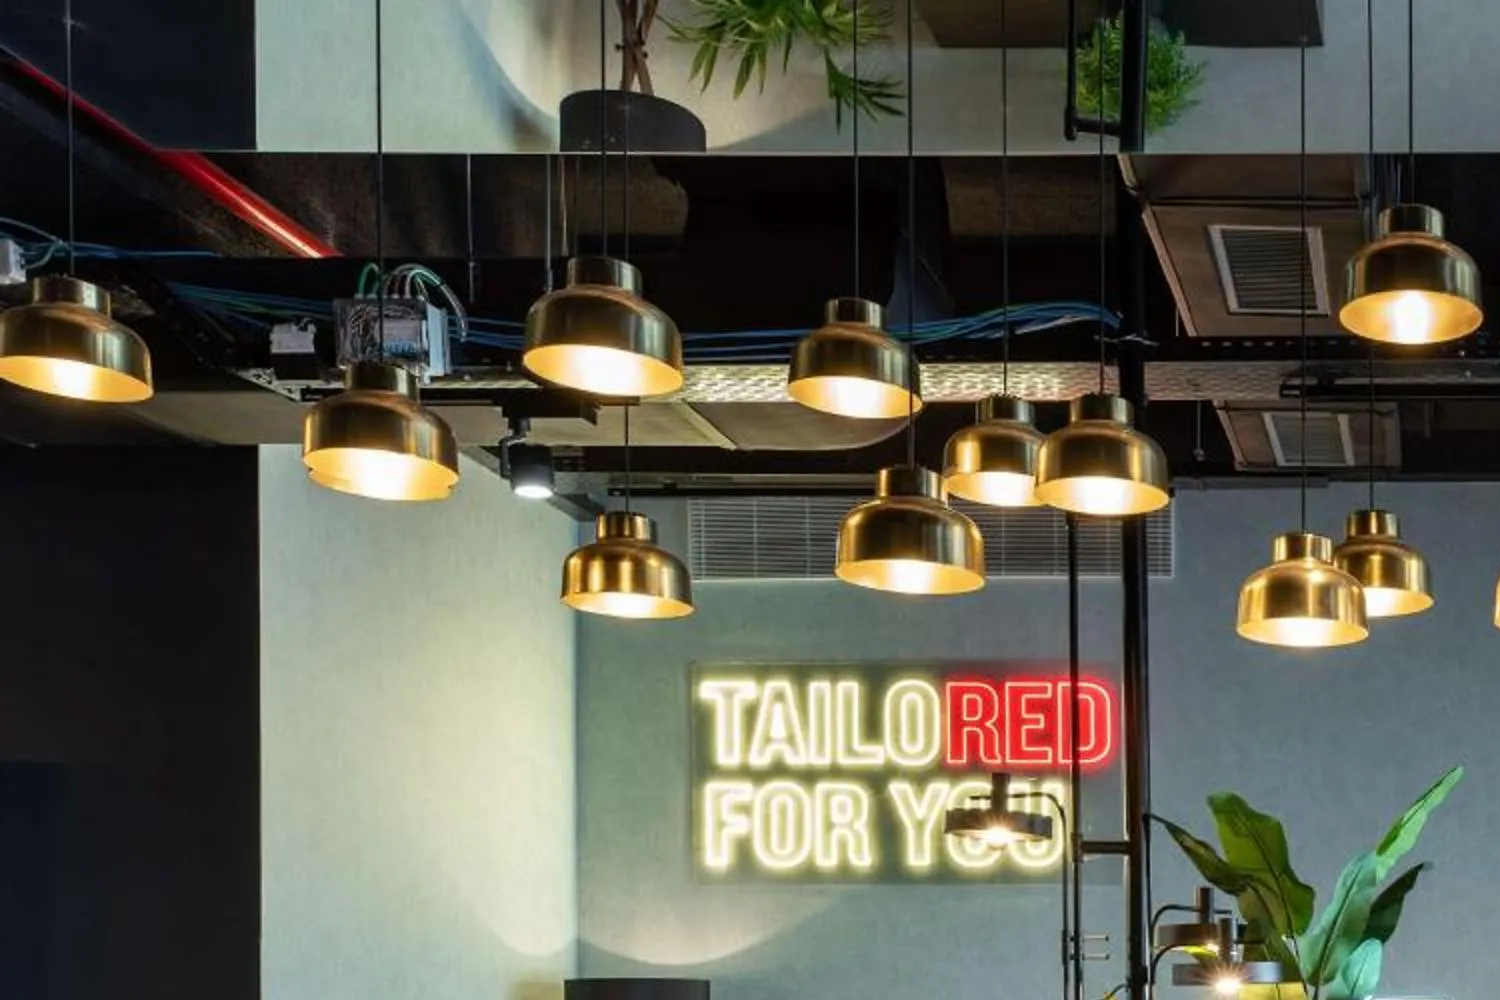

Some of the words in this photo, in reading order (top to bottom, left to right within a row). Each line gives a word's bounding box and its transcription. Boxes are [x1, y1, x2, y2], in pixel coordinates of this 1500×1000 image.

[699, 679, 1112, 766] TAILORED
[703, 780, 872, 868] FOR
[888, 780, 1066, 868] YOU
